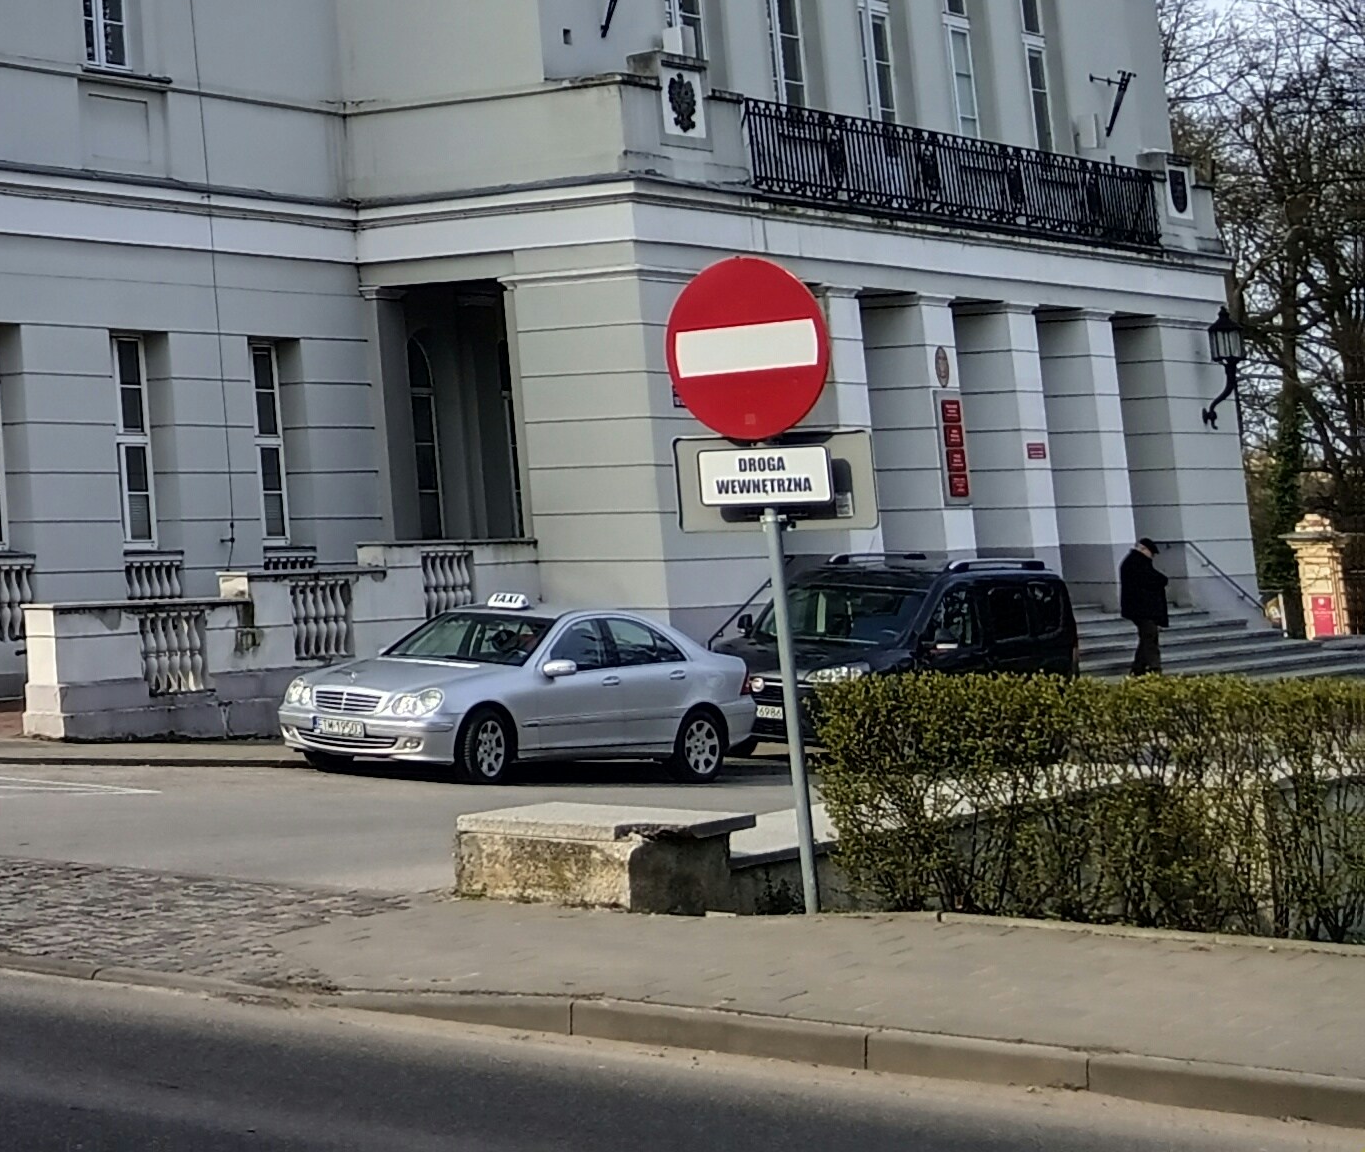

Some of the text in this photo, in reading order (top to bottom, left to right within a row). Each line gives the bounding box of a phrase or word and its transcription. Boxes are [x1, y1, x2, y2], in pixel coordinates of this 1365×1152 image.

[737, 456, 786, 473] DROGA
[716, 477, 813, 496] WEWNĘTRZNA
[493, 593, 520, 604] TAXI
